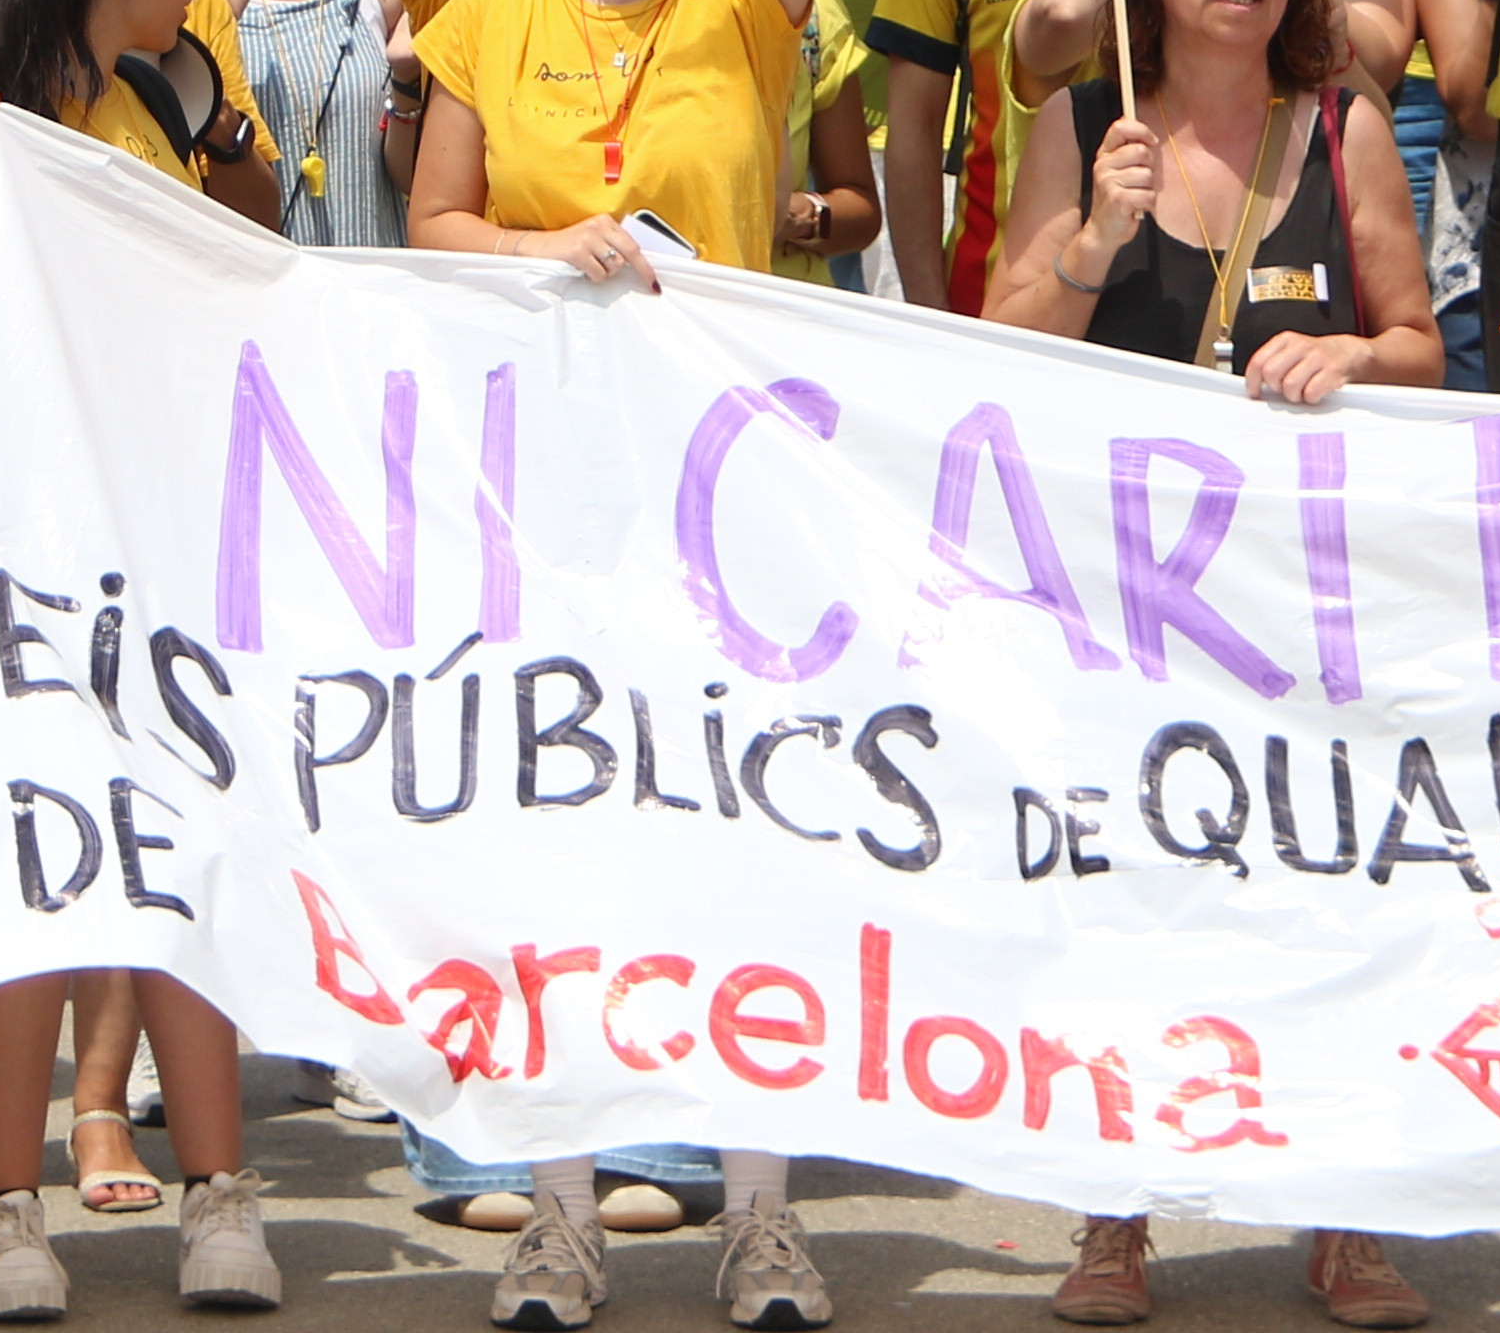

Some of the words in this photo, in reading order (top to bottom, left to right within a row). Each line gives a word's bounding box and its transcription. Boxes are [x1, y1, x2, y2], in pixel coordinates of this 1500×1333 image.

[215, 338, 522, 655] NI
[8, 777, 196, 923] DE
[1013, 784, 1111, 884] DE
[289, 867, 1290, 1153] Barcelona
